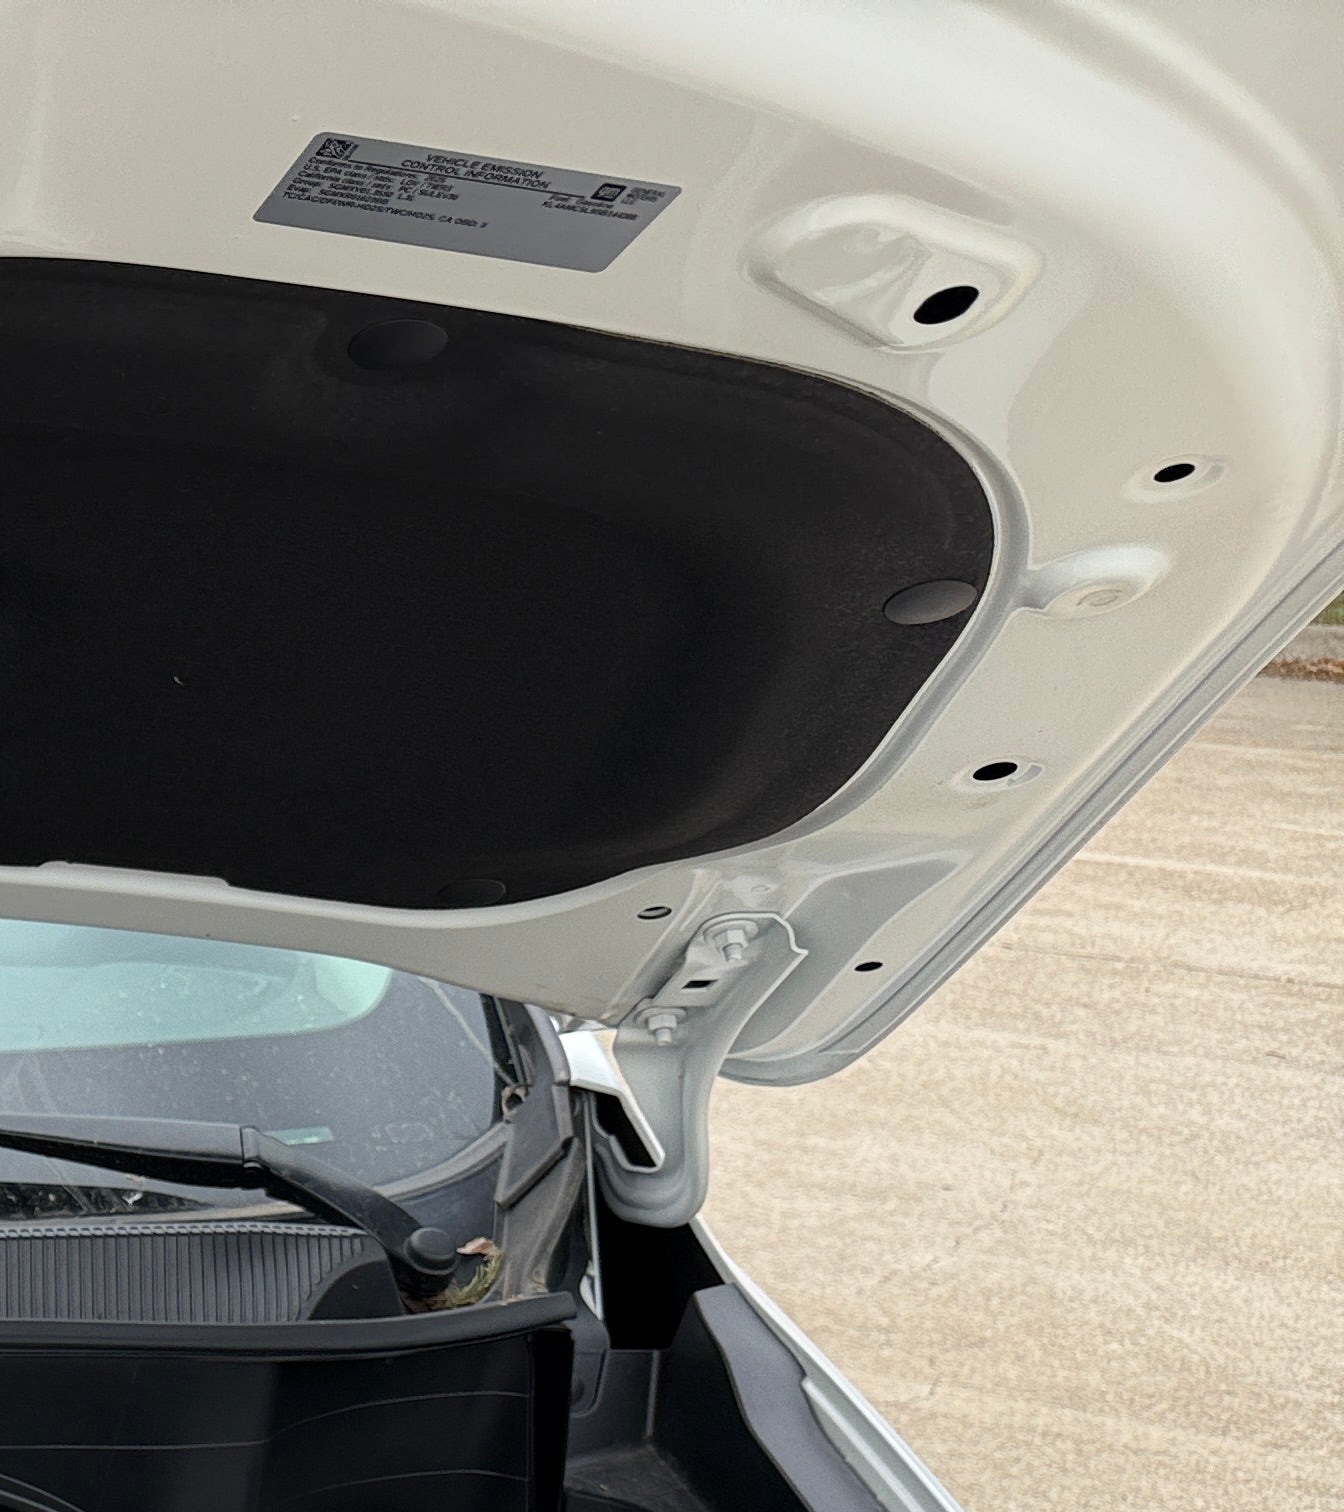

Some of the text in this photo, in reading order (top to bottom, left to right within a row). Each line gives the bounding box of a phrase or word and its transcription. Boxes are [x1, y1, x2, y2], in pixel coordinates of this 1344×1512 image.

[401, 159, 461, 175] CONTROL
[464, 169, 551, 189] INFORMATION
[426, 154, 544, 178] VEHICLE EMISSION
